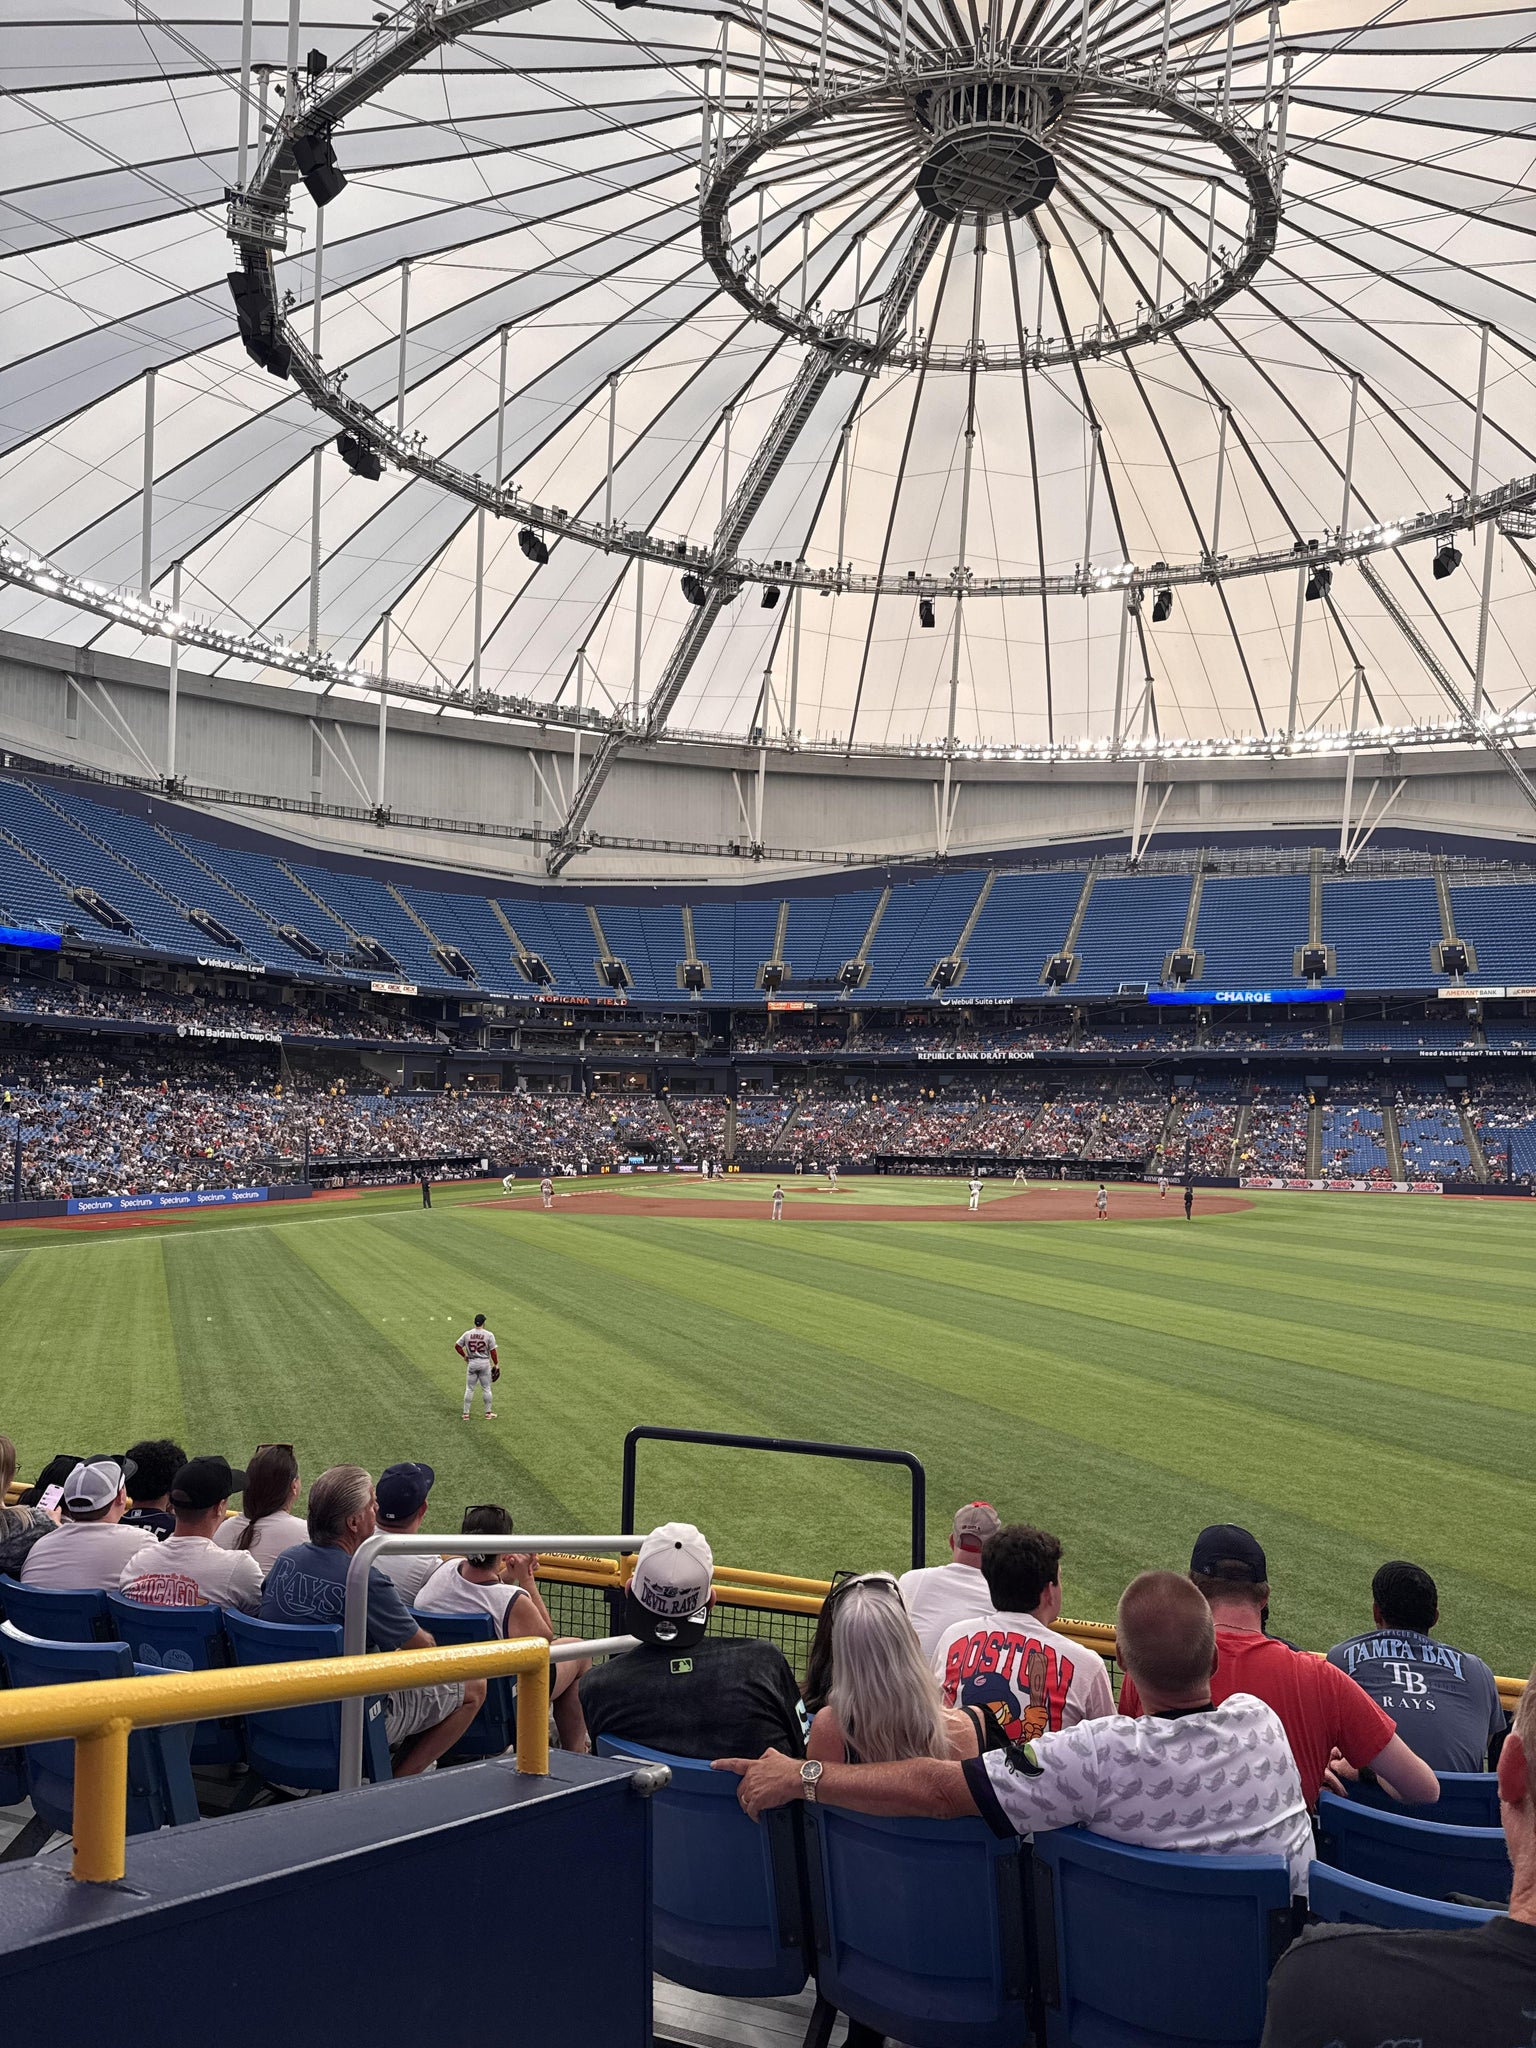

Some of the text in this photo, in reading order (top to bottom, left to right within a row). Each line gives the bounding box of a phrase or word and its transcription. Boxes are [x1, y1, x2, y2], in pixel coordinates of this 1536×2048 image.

[208, 959, 266, 973] Webull Suite Level
[532, 994, 590, 1005] TROPICANA
[596, 998, 628, 1006] FIELD
[994, 997, 1013, 1005] Level
[1215, 992, 1271, 1002] CHARGE
[188, 1027, 282, 1042] The Baldwin Group Club
[918, 1052, 953, 1060] REPUBLIC
[980, 1052, 1007, 1060] DRAFT
[160, 1196, 188, 1206] Spectrum
[197, 1194, 224, 1203] Spectrum
[232, 1192, 257, 1200] Spectrum
[78, 1201, 110, 1212] Spectrum
[120, 1199, 150, 1208] Spectrum
[468, 1340, 486, 1353] 52
[264, 1555, 347, 1617] RAYS
[641, 1581, 669, 1614] DEVIL
[670, 1591, 700, 1615] RAYS
[1343, 1638, 1466, 1682] TAMPA BAY
[944, 1630, 1075, 1733] BOSTON
[1383, 1661, 1429, 1695] TB
[1382, 1695, 1436, 1711] RAYS
